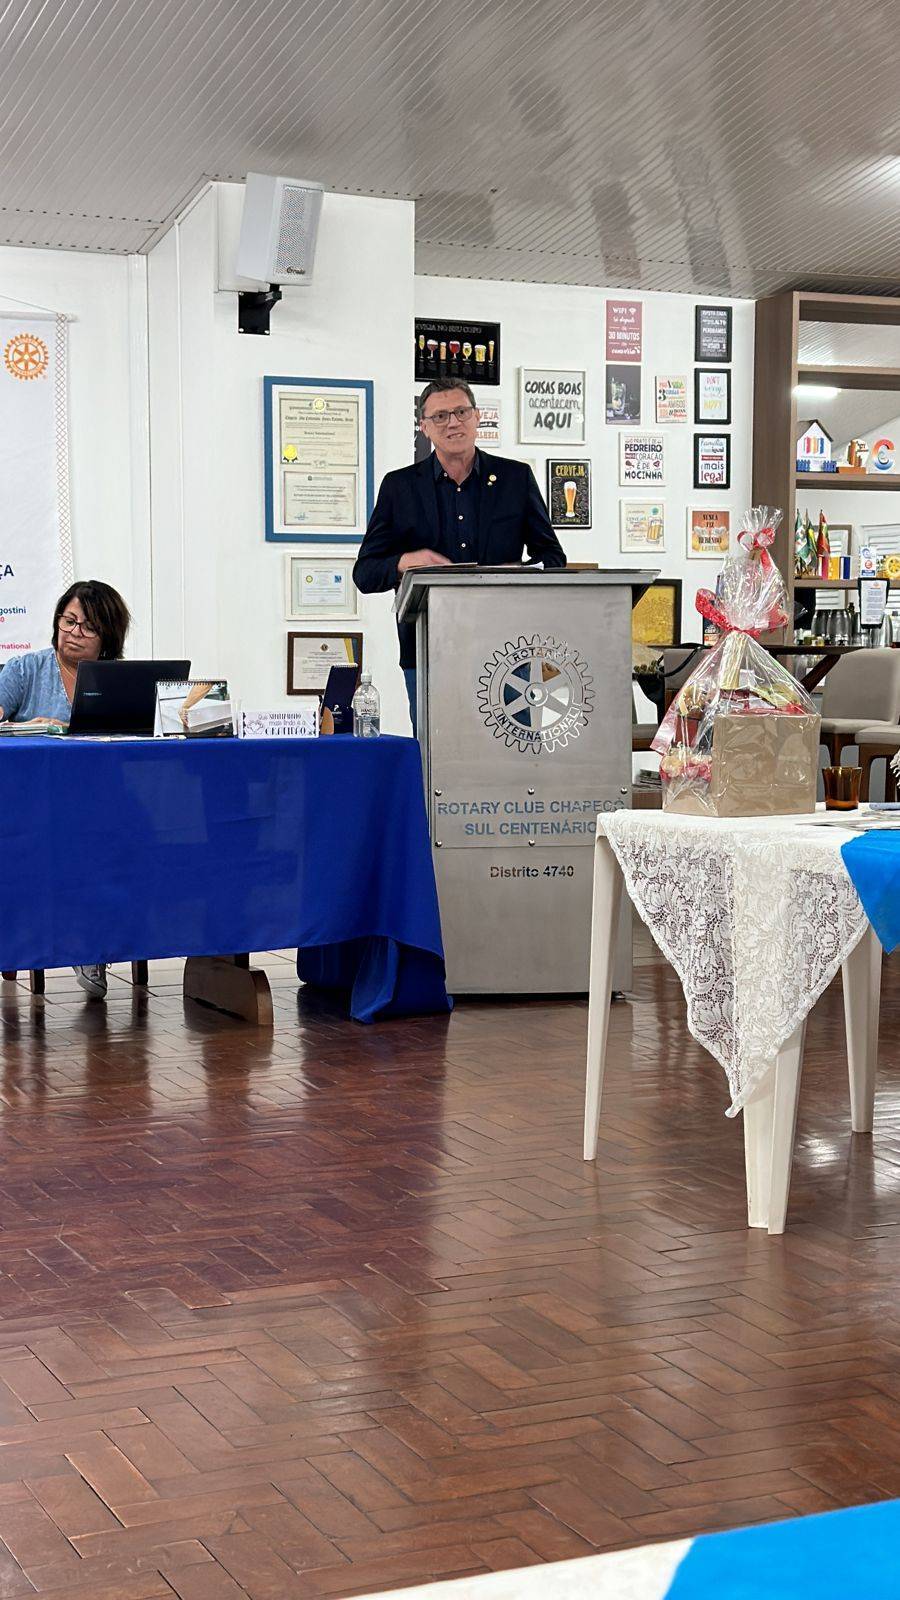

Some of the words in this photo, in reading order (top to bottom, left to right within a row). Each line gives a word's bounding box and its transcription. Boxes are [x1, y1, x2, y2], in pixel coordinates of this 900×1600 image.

[617, 331, 640, 340] MINUTOS
[525, 381, 556, 395] COISAS
[557, 382, 582, 395] BOAS
[528, 396, 581, 410] acontecem
[533, 411, 572, 431] AQUI
[624, 443, 663, 453] PEDREIRO
[555, 464, 585, 477] CERVEJA
[704, 461, 725, 470] mais
[624, 470, 663, 480] MOCINHA
[700, 470, 724, 484] legal
[513, 647, 571, 662] ROTARY
[496, 711, 580, 741] INTERNATIONAL
[438, 801, 500, 815] ROTARY
[503, 800, 545, 814] CLUB
[464, 822, 495, 836] SUL
[499, 819, 597, 835] CENTENÁRIO
[490, 866, 539, 878] Distrito
[543, 865, 574, 877] 4740
